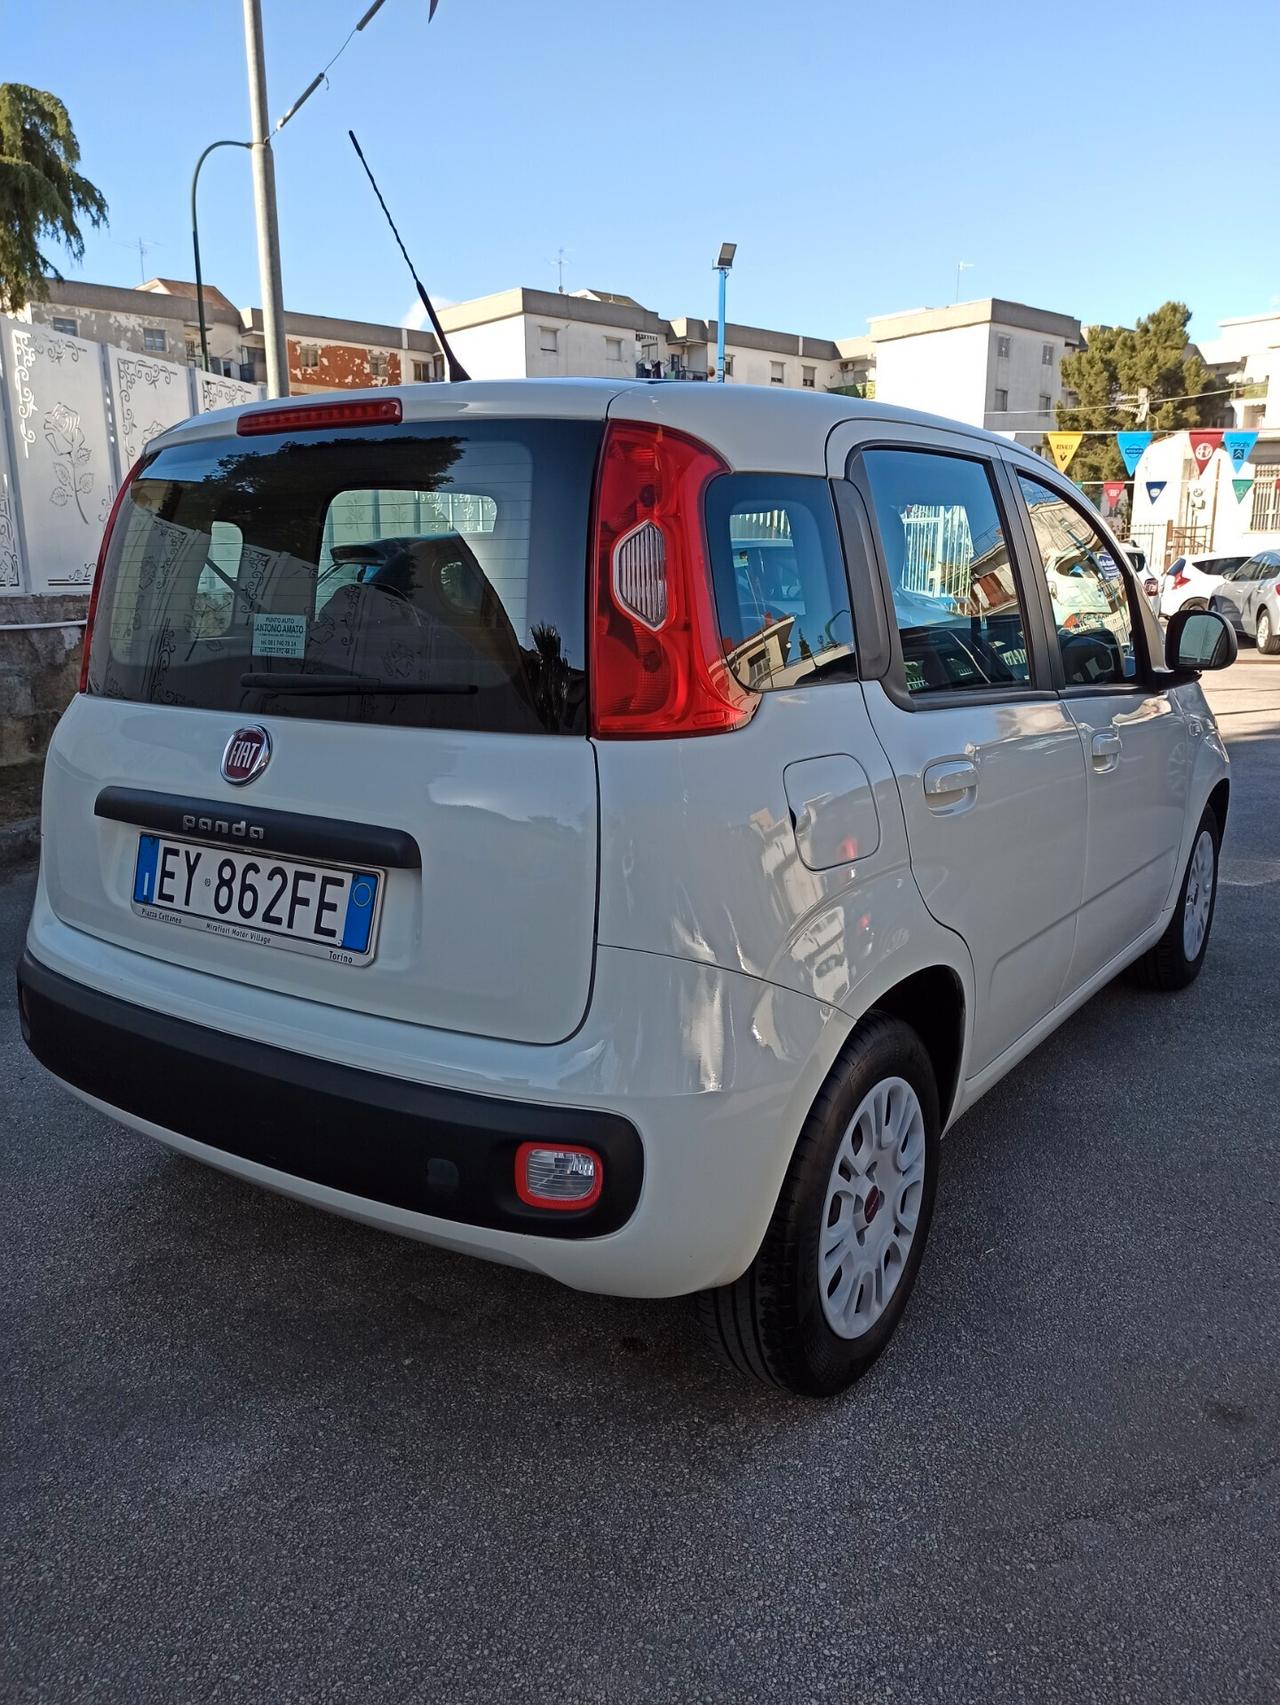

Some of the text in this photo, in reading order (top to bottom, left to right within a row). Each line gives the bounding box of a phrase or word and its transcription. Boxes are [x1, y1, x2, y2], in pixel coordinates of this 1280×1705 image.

[255, 623, 304, 634] ANTONIO AMATO
[228, 741, 260, 768] FIAT
[183, 815, 264, 840] panda
[158, 846, 345, 938] EY 862FE
[141, 908, 158, 918] Piazza
[232, 928, 249, 938] Motor
[250, 932, 271, 944] Village
[329, 951, 353, 963] Torino
